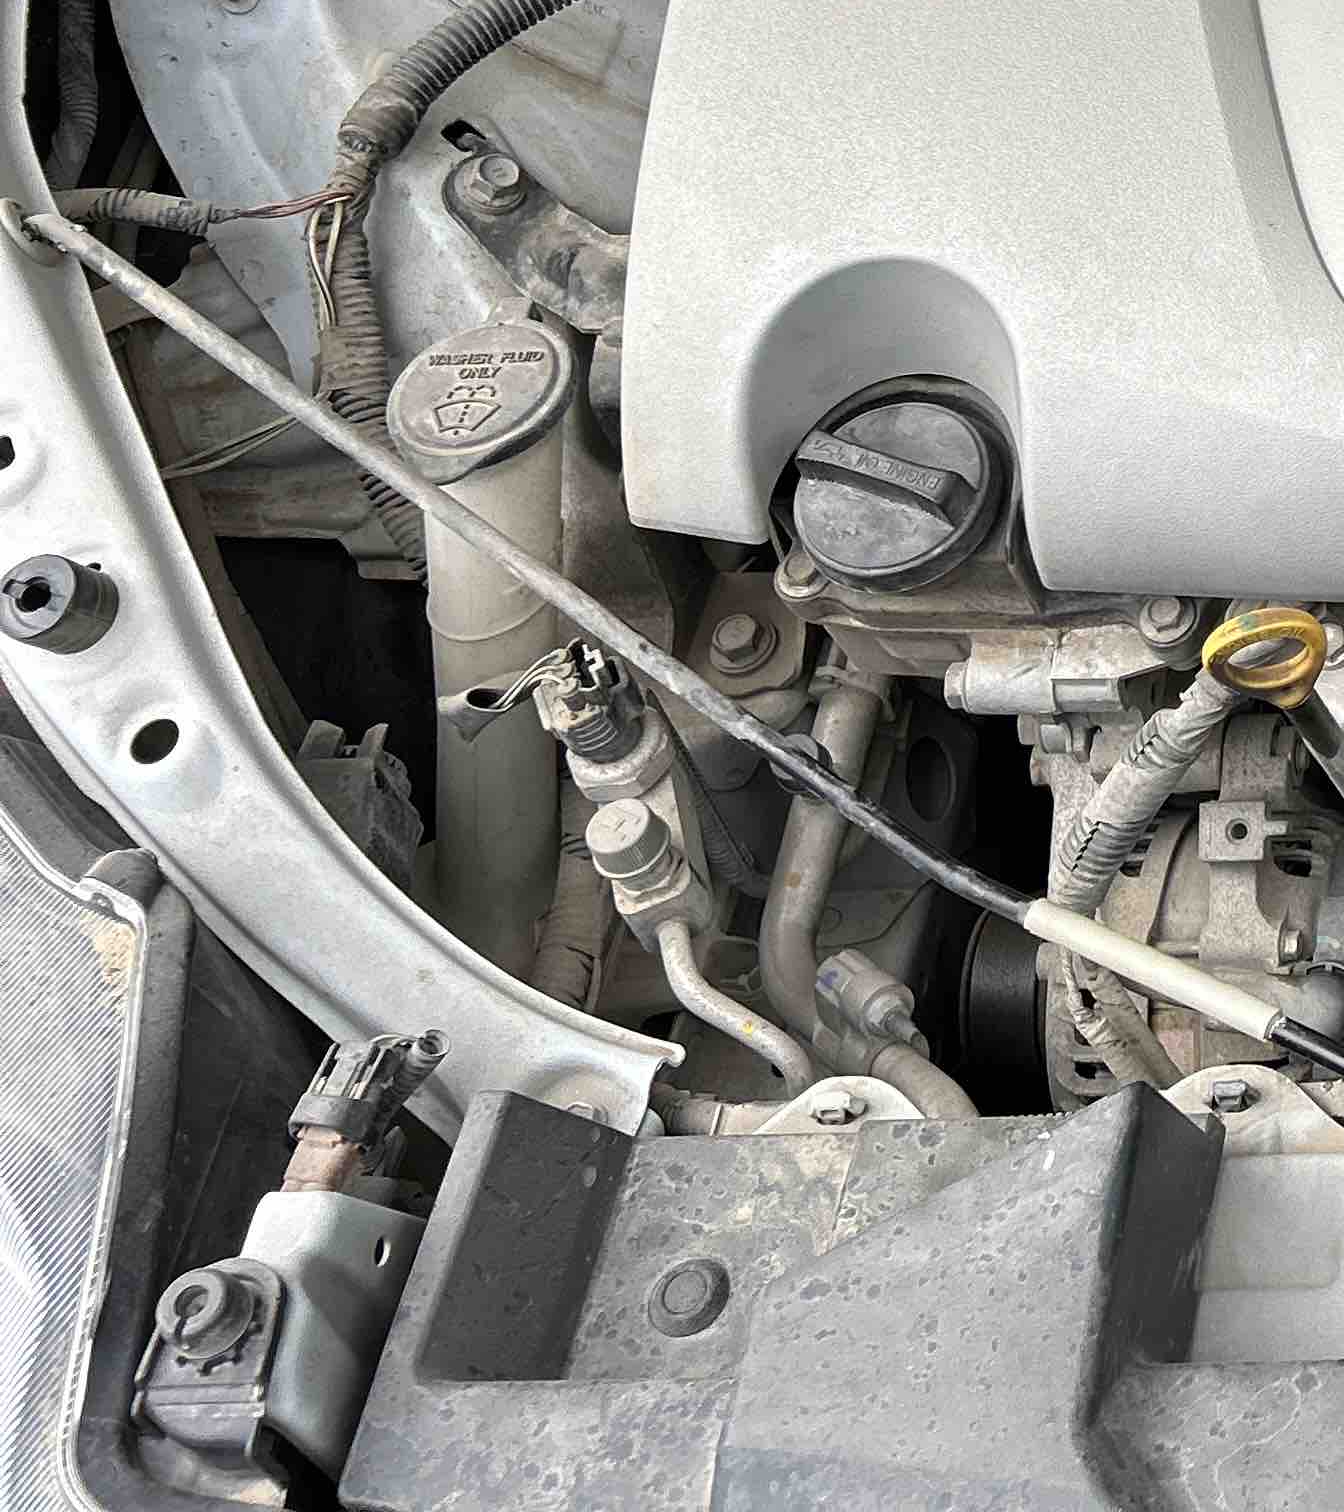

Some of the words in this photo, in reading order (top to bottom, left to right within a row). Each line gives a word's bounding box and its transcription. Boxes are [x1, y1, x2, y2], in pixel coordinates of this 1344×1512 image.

[429, 353, 494, 367] WASHER
[500, 351, 546, 364] FLUID
[458, 366, 502, 380] ONLY
